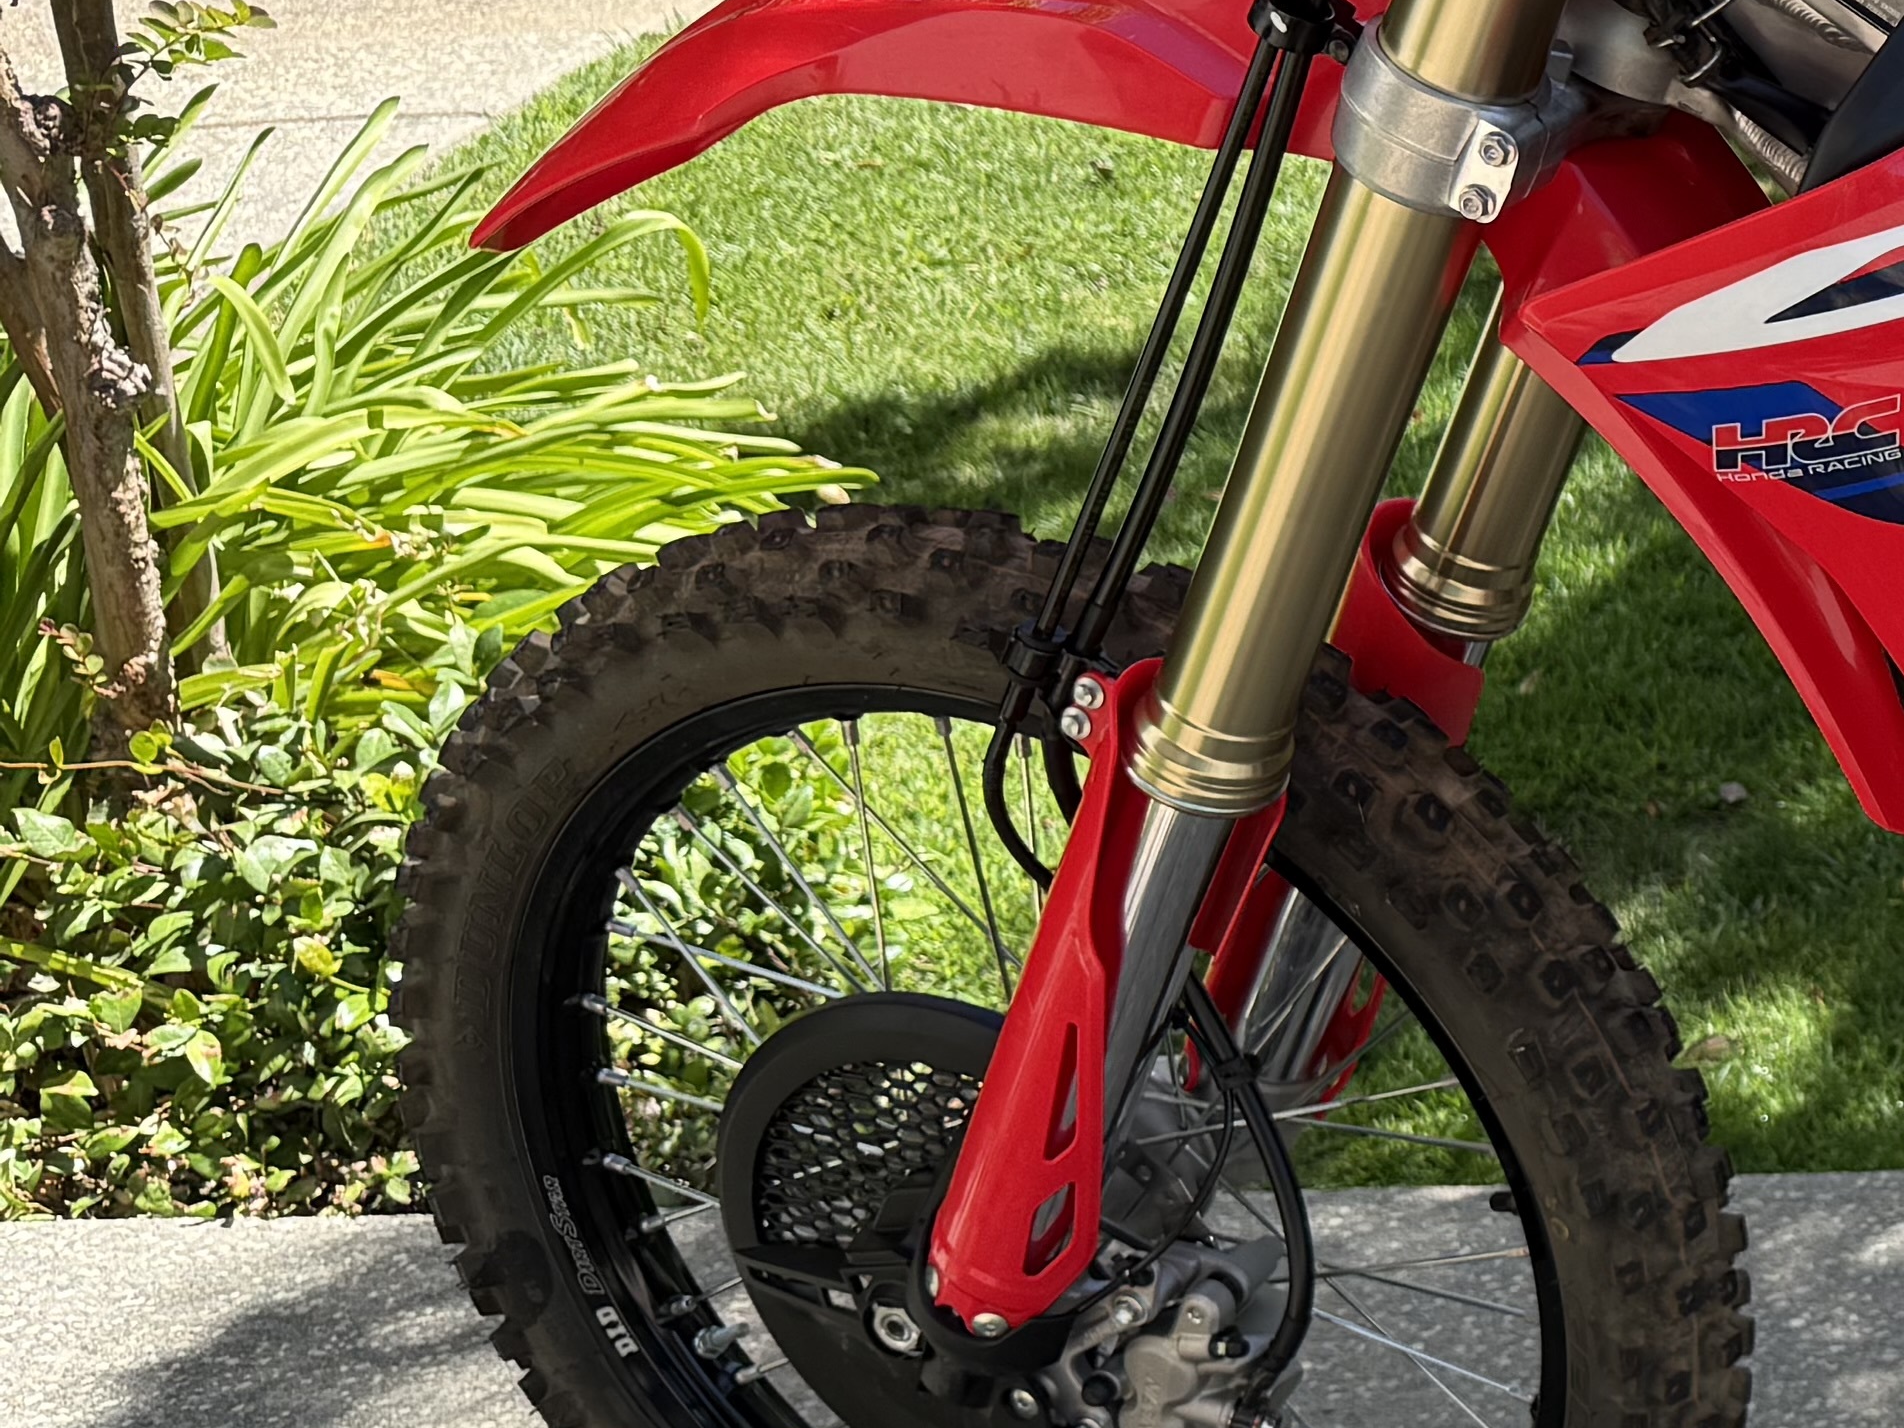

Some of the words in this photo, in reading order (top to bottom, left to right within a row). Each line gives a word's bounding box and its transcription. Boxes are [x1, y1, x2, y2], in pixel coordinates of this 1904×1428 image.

[1712, 393, 1901, 471] HRC
[1717, 467, 1804, 482] Honda
[1808, 448, 1901, 475] RACING
[453, 756, 572, 1019] DUNLOP
